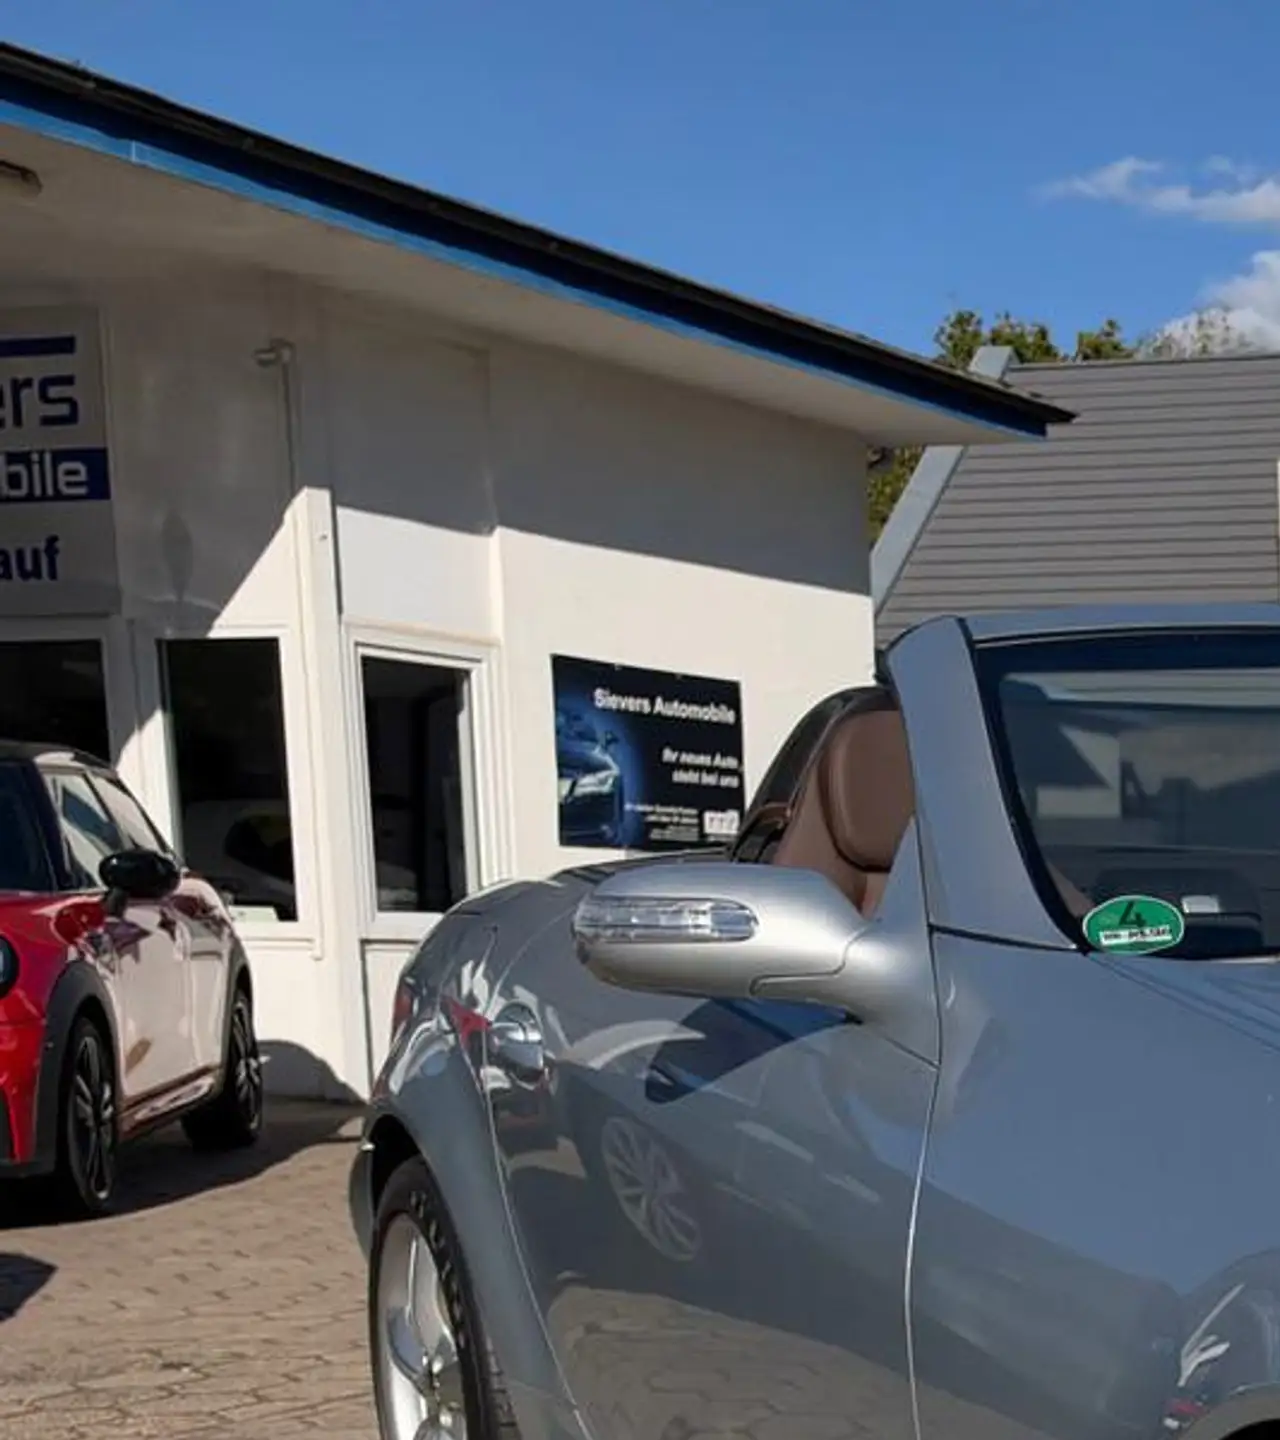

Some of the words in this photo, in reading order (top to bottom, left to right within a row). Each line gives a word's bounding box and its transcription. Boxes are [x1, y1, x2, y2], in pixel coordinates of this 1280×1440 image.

[0, 374, 79, 428] rs
[594, 687, 651, 714] Sievers
[653, 695, 735, 724] Automobile
